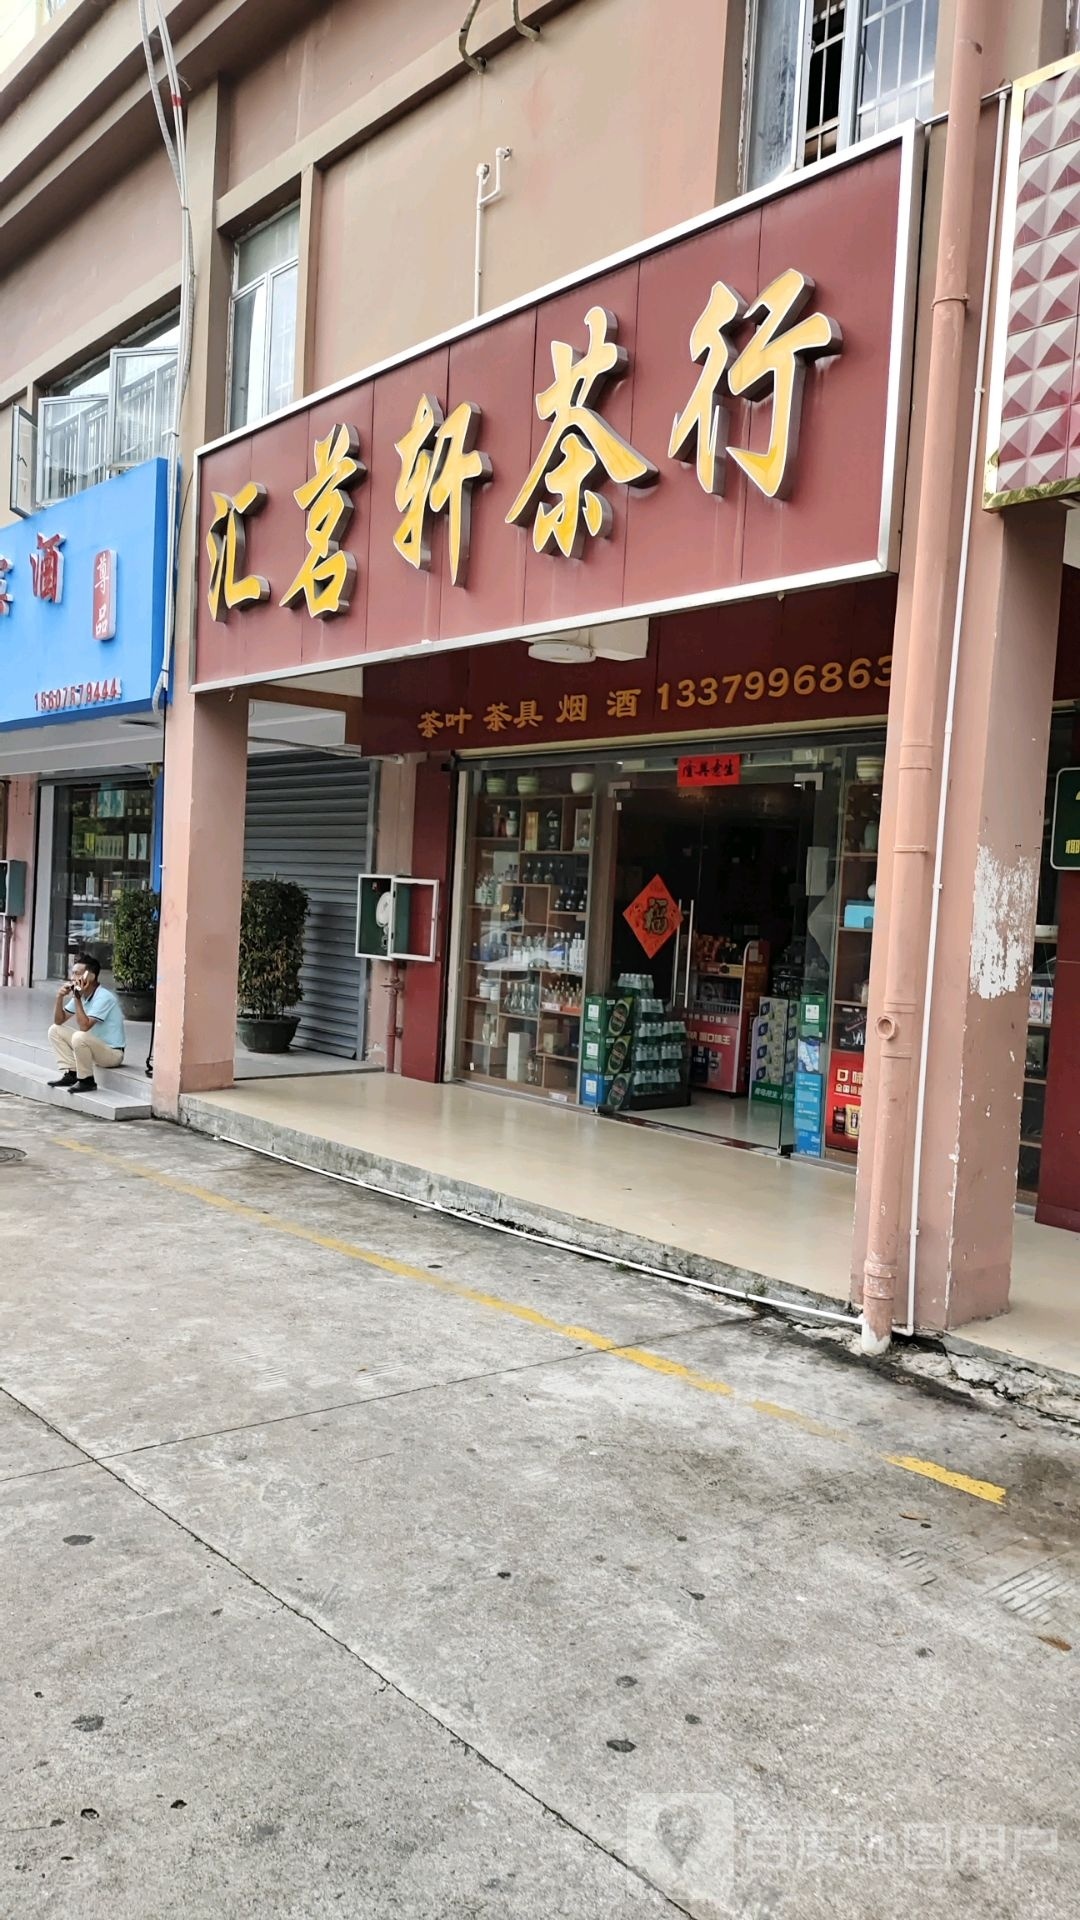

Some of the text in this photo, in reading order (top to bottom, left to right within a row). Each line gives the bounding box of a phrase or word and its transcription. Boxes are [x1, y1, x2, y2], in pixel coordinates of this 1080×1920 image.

[206, 267, 842, 622] 汇茗轩茶行
[95, 553, 110, 635] 尊品
[417, 707, 472, 738] 茶叶
[483, 700, 543, 731] 茶具
